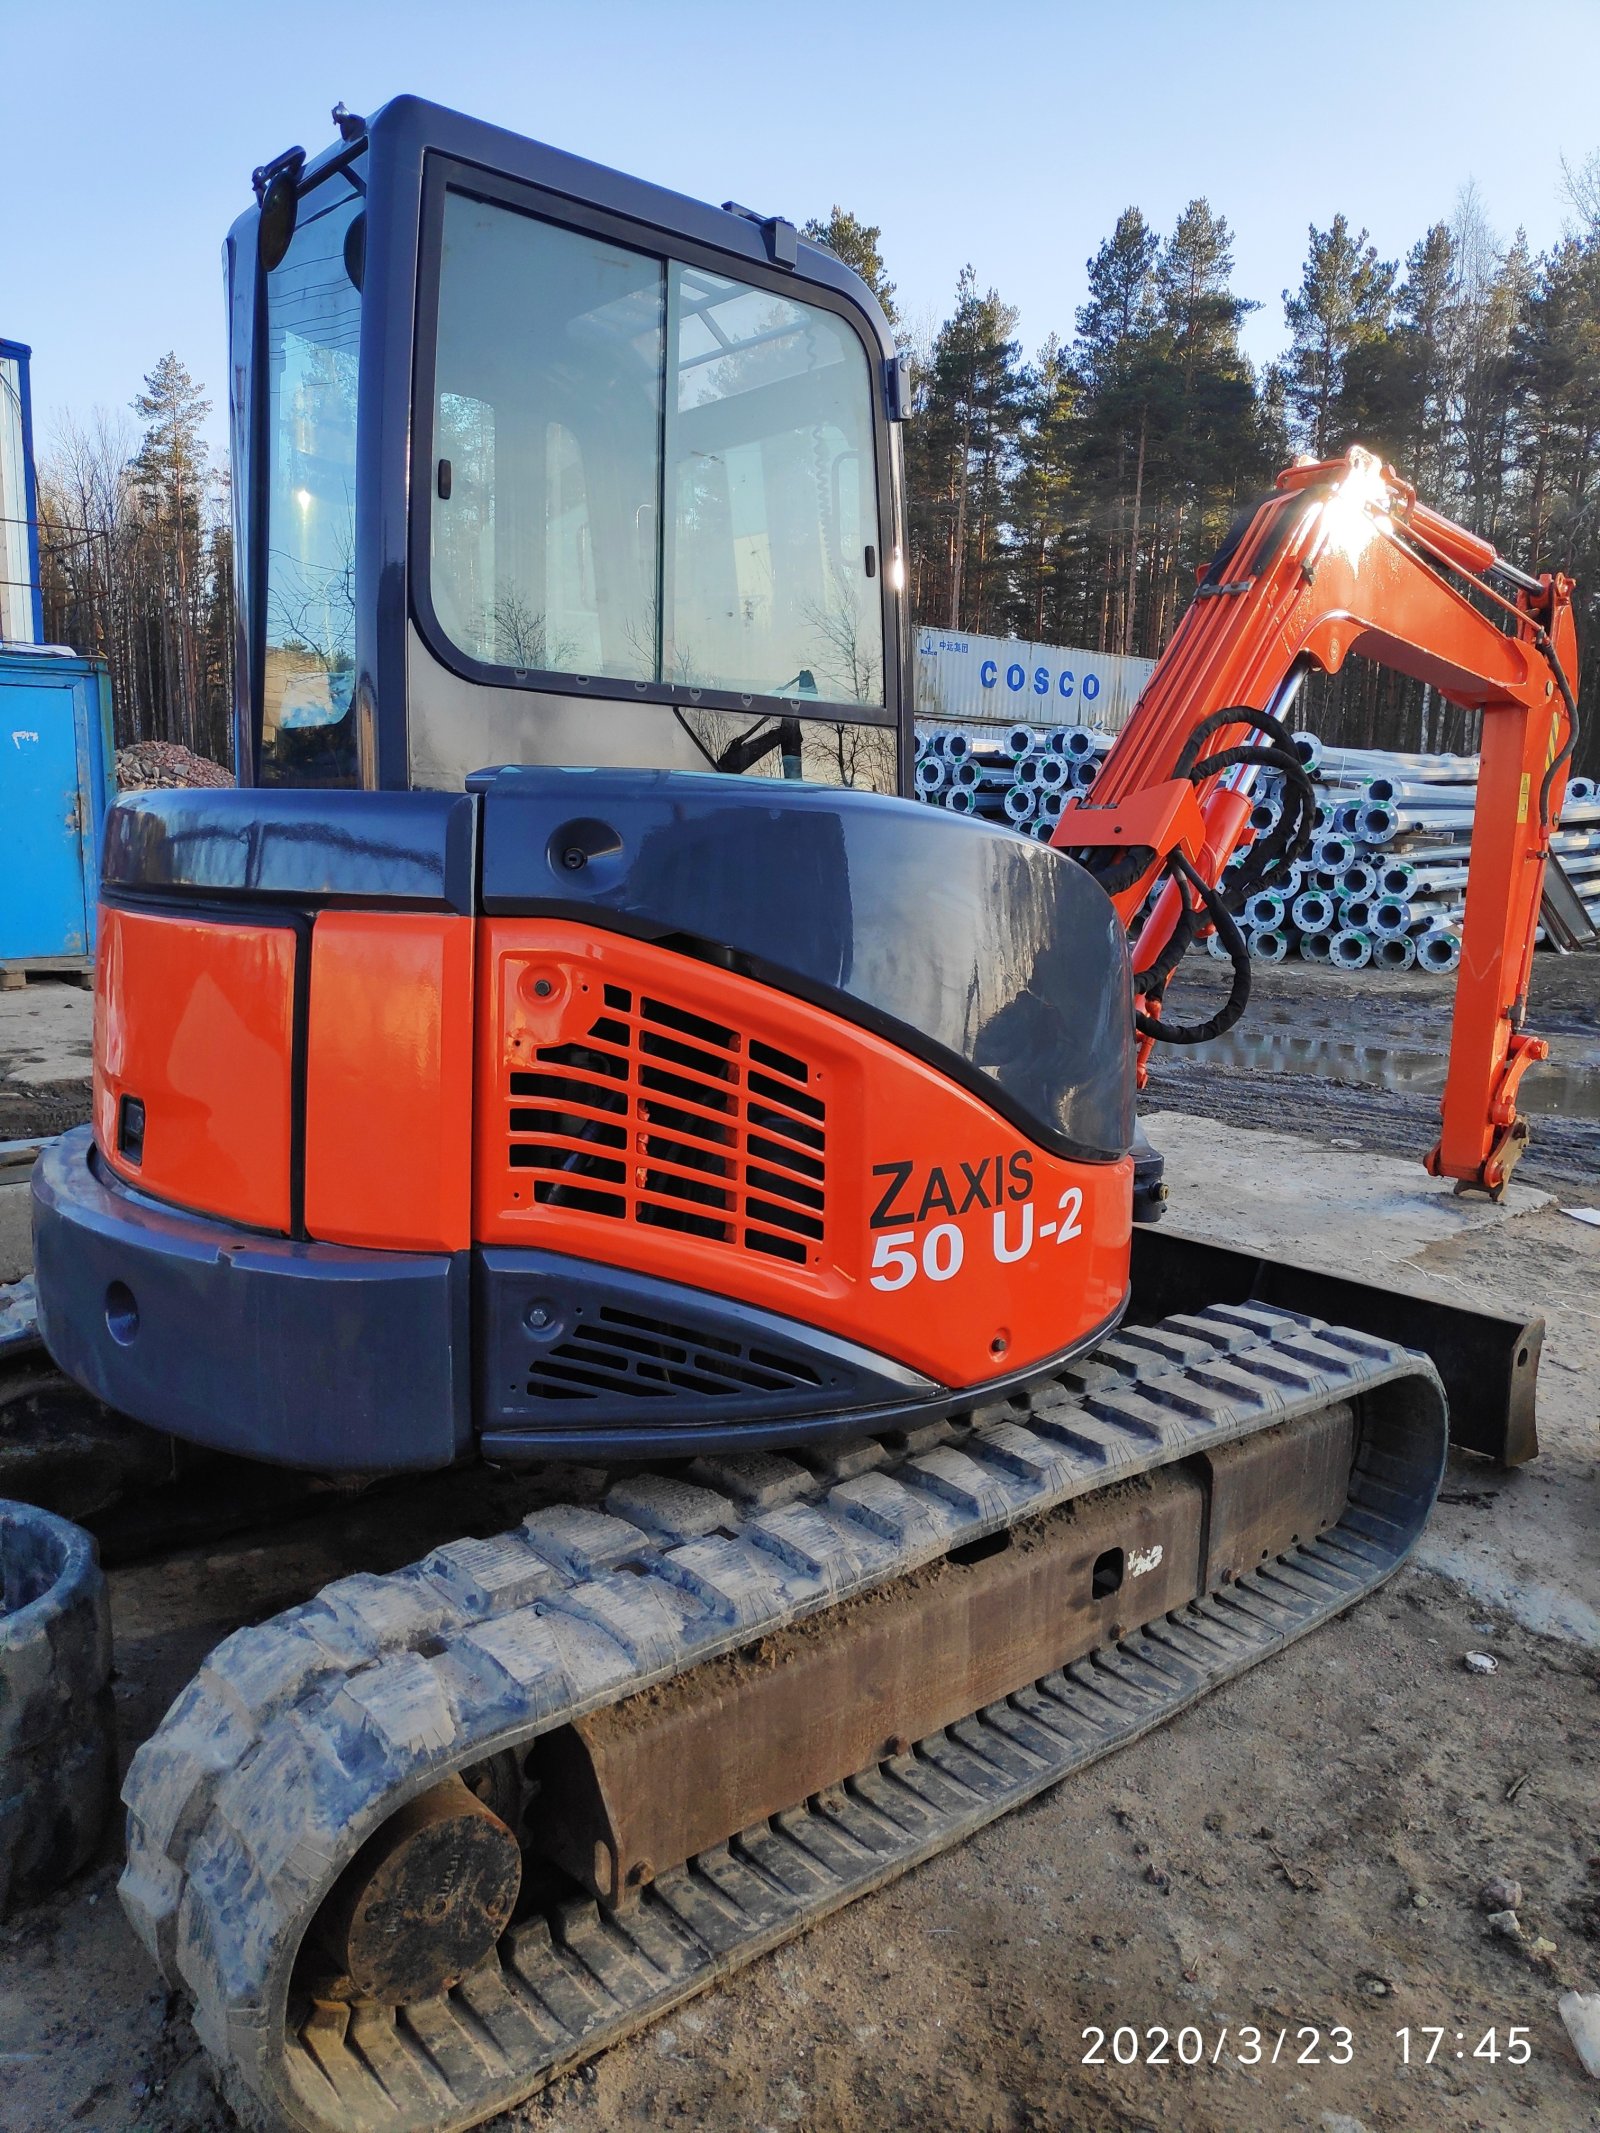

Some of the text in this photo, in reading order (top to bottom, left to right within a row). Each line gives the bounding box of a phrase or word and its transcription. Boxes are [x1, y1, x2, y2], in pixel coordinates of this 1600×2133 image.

[939, 638, 969, 654] 中远集团
[980, 660, 1100, 700] COSCO
[869, 1149, 1034, 1230] ZAXIS
[869, 1186, 1083, 1292] 50 U-2
